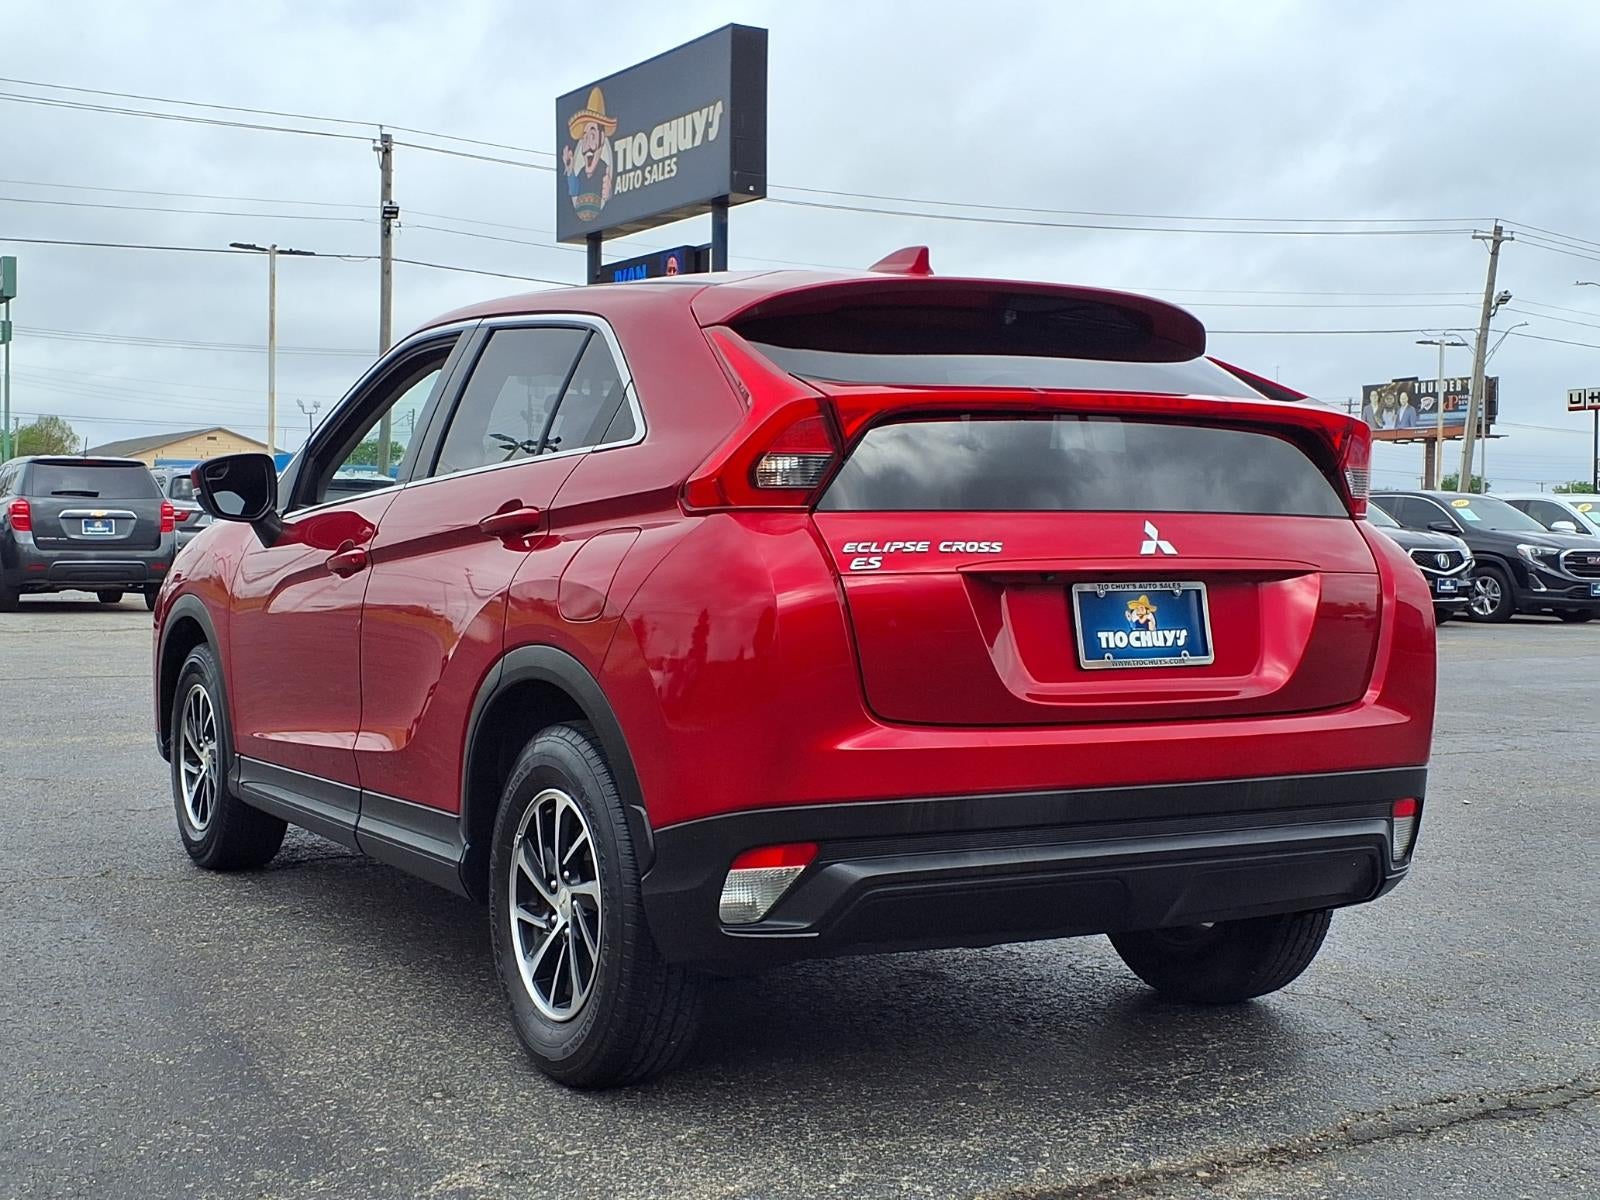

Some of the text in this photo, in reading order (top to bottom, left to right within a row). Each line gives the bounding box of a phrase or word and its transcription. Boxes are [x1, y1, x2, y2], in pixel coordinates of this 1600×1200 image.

[614, 100, 723, 172] TIO CHUY'S
[614, 157, 677, 195] AUTO SALES
[842, 541, 1003, 553] ECLIPSE CROSS
[850, 556, 882, 570] ES
[1097, 583, 1109, 591] TIO
[1097, 629, 1188, 648] TIO CHUY'S
